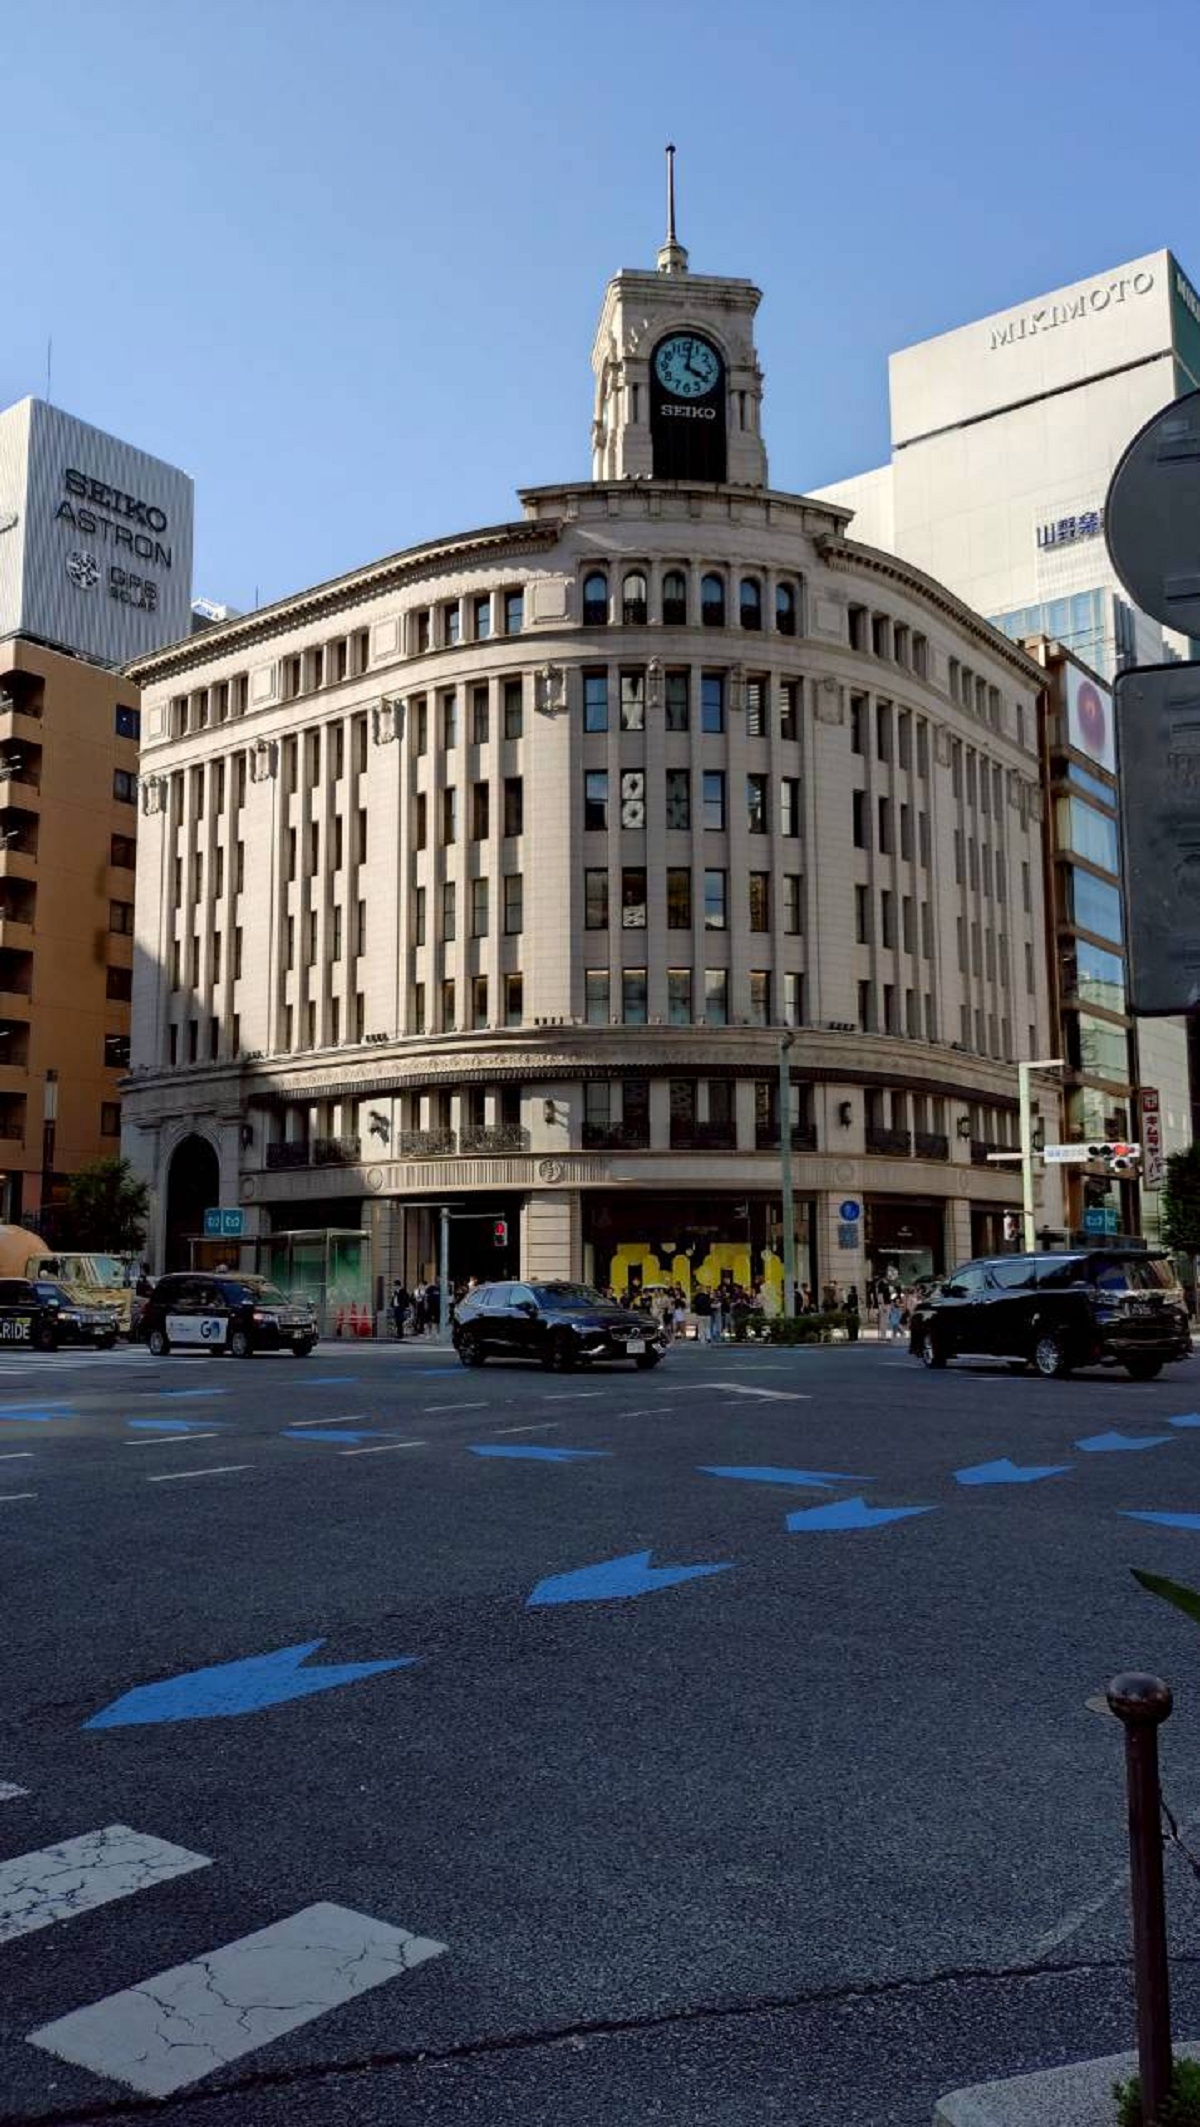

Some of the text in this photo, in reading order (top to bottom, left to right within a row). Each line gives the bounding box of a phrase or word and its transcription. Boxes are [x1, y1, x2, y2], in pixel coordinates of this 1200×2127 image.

[989, 272, 1154, 349] MIKIMOTO
[660, 404, 716, 420] SEIKO
[65, 469, 168, 533] SEIKO
[55, 501, 172, 569] ASTRON
[111, 567, 157, 599] GPS
